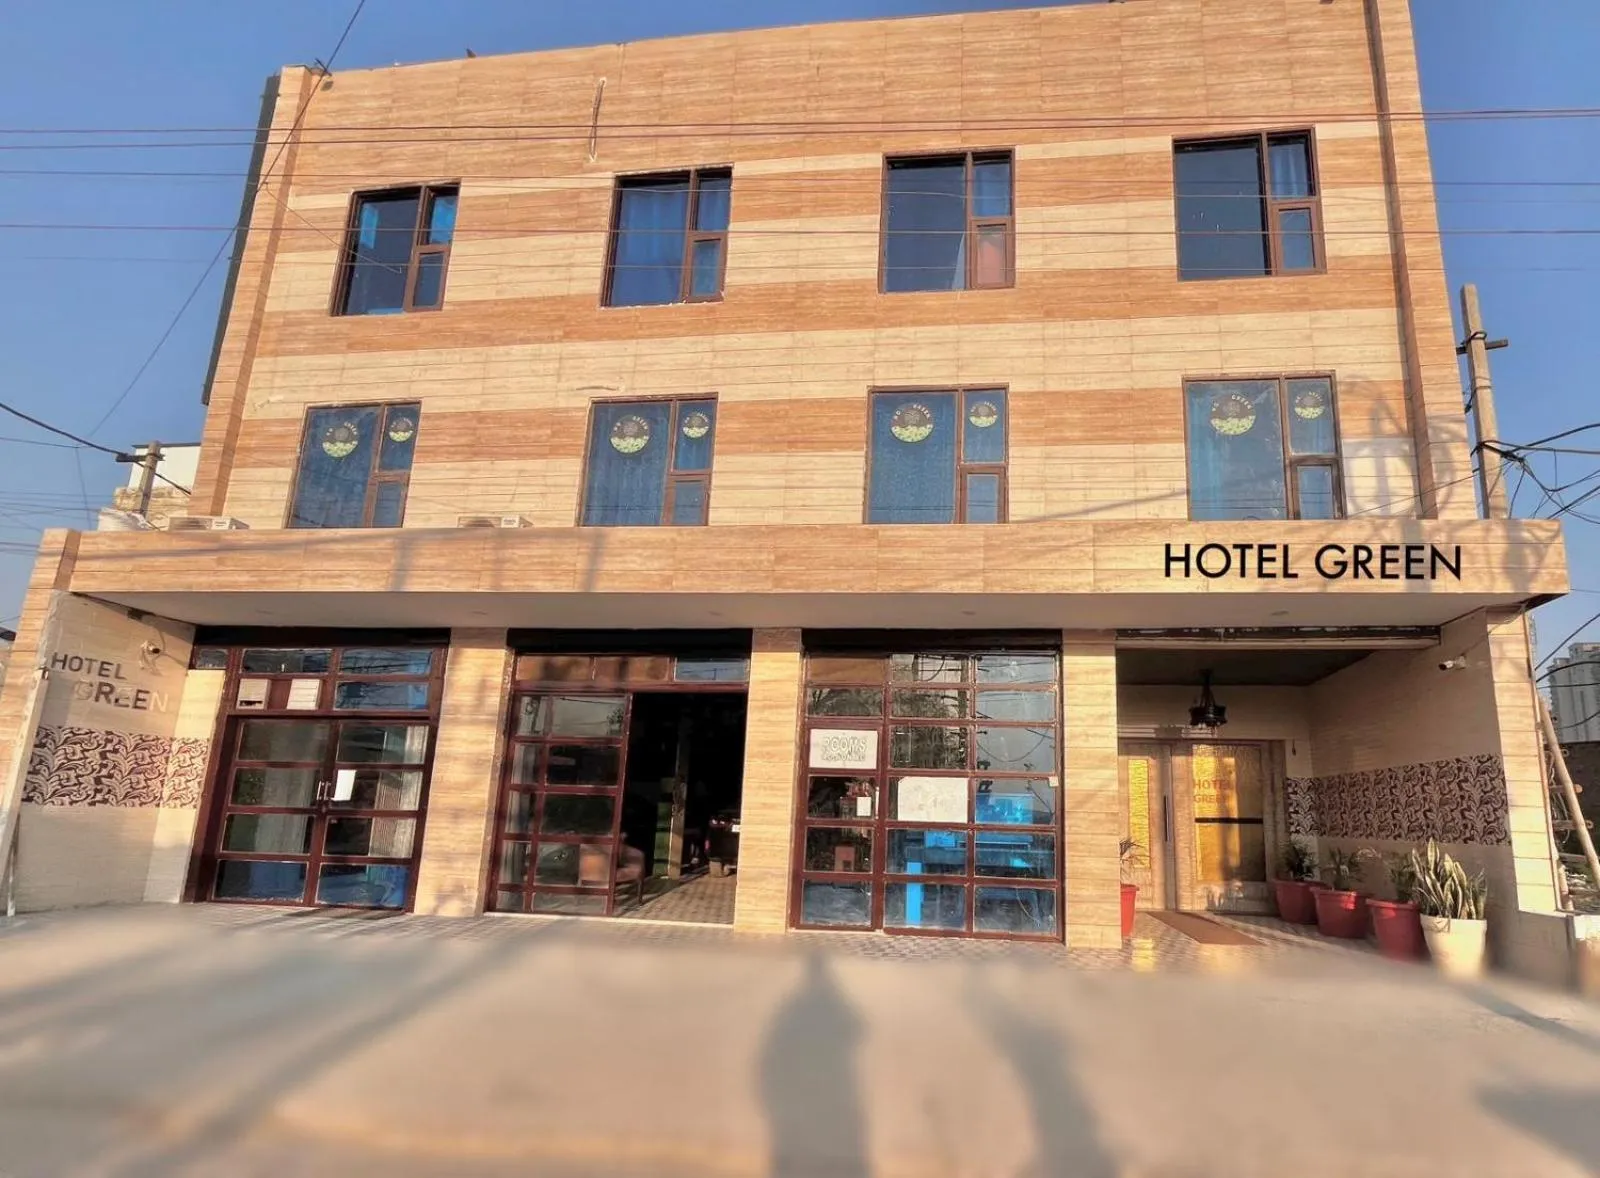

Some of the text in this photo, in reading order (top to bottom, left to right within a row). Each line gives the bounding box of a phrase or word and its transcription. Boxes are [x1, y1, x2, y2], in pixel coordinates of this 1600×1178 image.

[1164, 543, 1462, 581] HOTEL GREEN
[50, 652, 127, 680] HOTEL
[73, 680, 169, 712] GREEN
